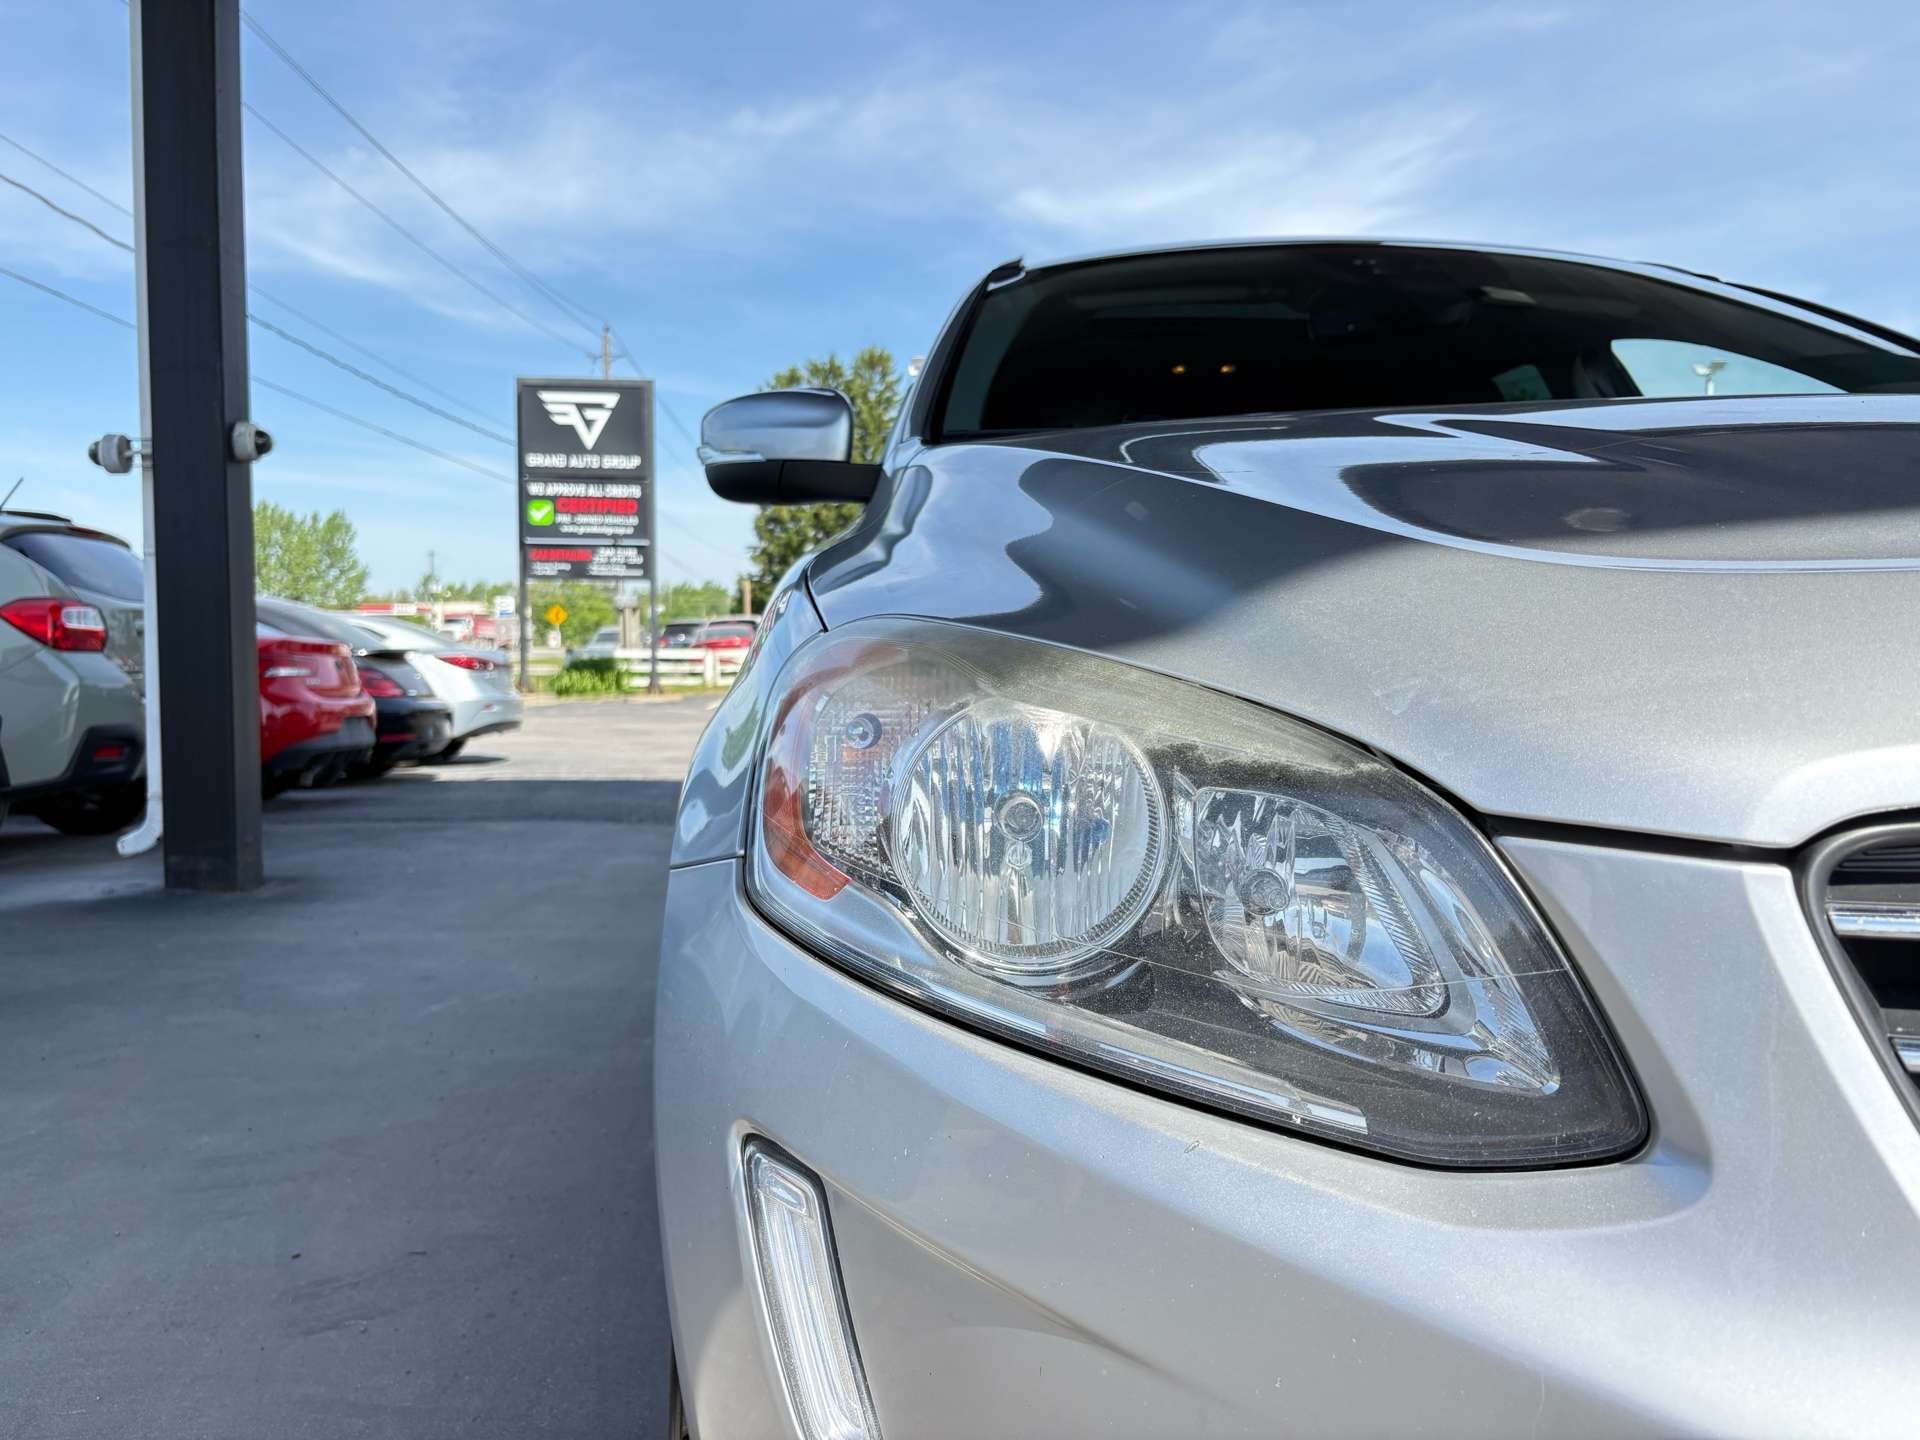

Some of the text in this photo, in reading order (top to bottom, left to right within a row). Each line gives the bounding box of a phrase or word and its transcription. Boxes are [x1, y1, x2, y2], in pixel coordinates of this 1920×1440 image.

[526, 453, 641, 469] GRAND AUTO GROUP
[527, 482, 545, 496] WE
[546, 483, 586, 497] APPROVE
[587, 484, 604, 498] ALL
[556, 497, 638, 514] CERTIFIED
